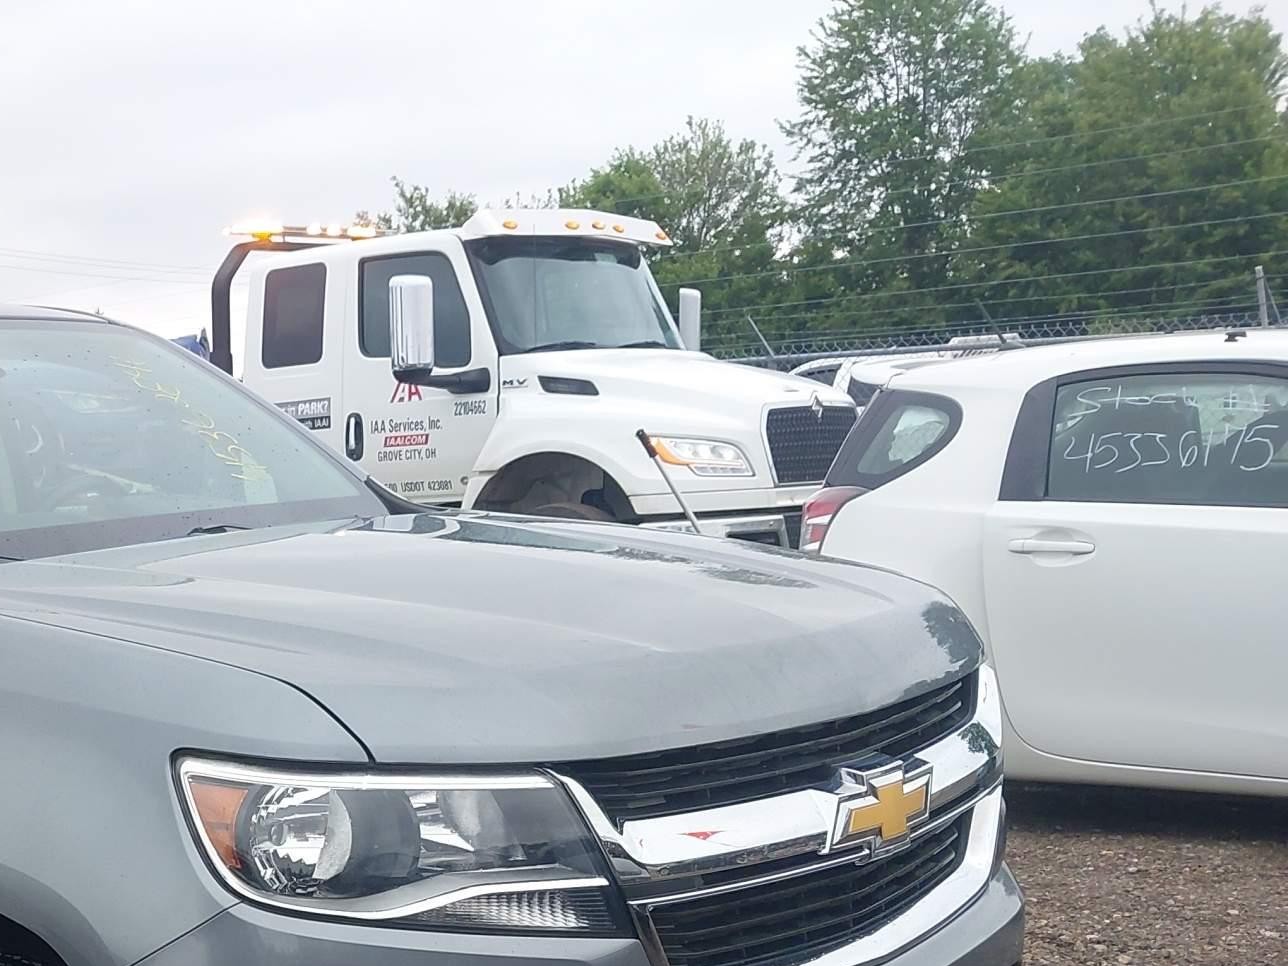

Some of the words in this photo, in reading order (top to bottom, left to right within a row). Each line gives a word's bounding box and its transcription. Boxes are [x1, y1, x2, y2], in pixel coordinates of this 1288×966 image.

[298, 401, 329, 416] PARK?
[1067, 384, 1201, 418] Stock
[370, 420, 386, 434] IAA
[388, 417, 427, 434] Services,
[428, 416, 443, 430] Inc.
[377, 450, 403, 462] GROVE
[404, 448, 424, 461] CITY,
[425, 448, 437, 459] OH
[400, 481, 425, 493] USDOT
